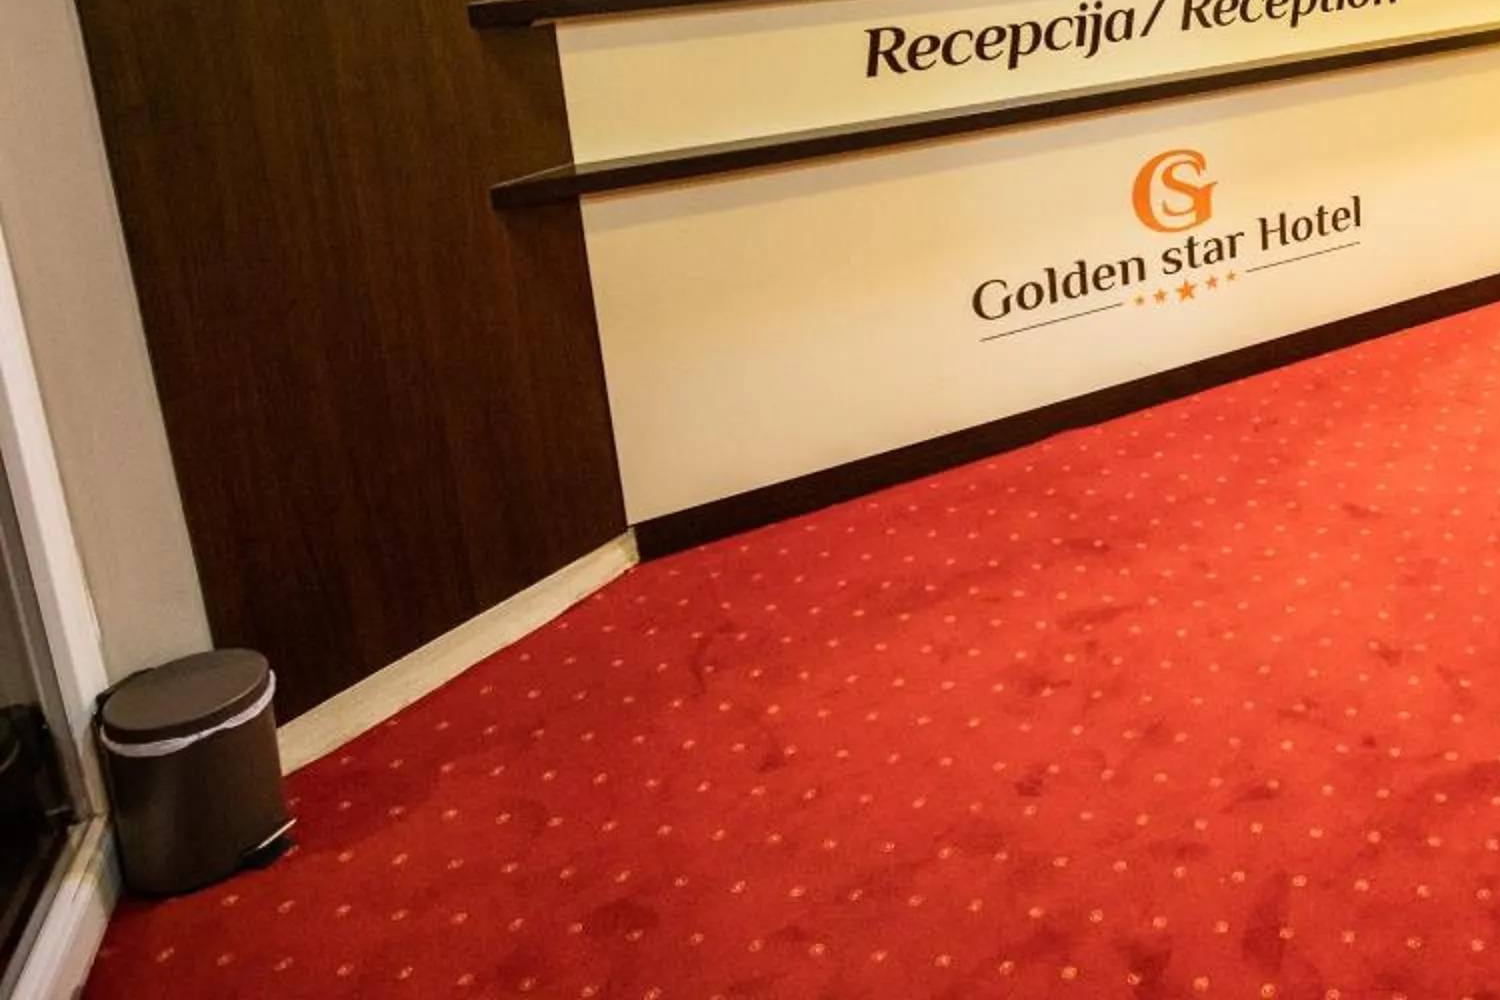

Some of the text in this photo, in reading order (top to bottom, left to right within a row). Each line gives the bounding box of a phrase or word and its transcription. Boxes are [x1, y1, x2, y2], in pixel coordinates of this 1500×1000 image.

[972, 195, 1362, 321] Golden star Hotel
